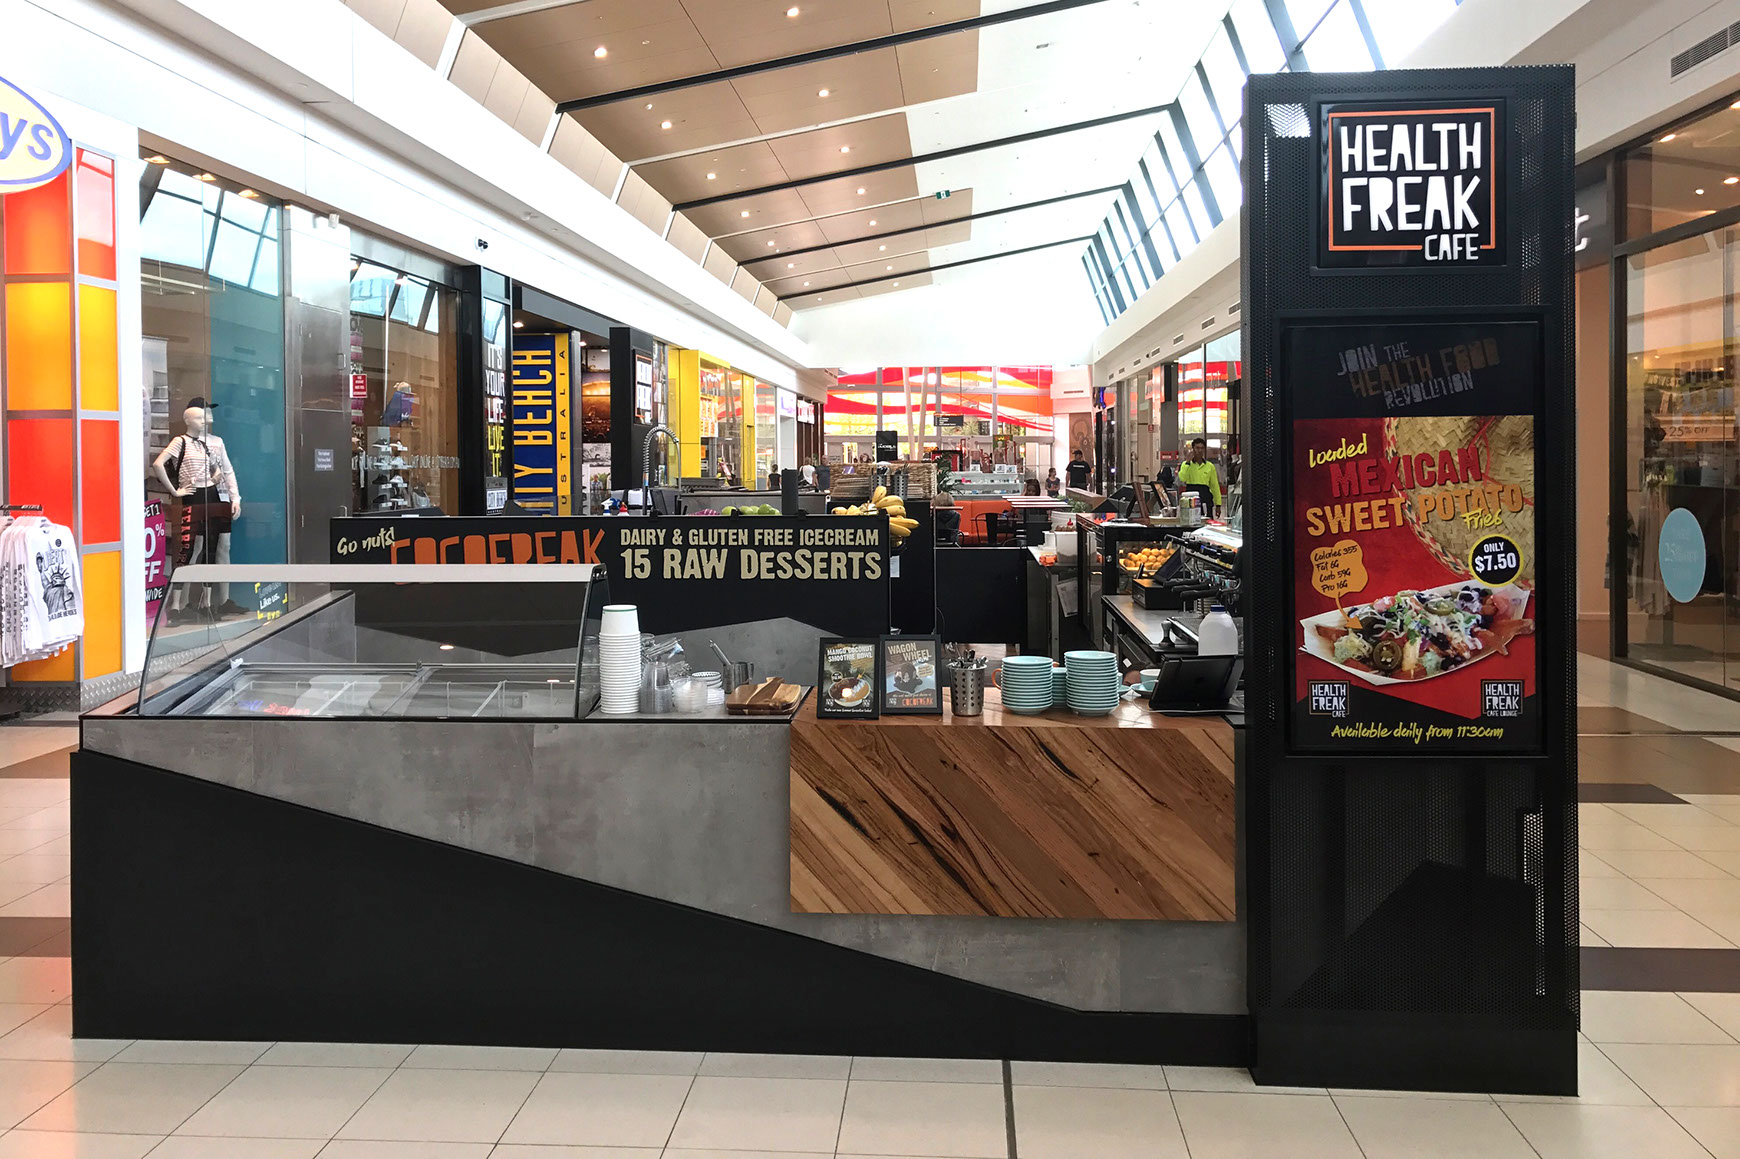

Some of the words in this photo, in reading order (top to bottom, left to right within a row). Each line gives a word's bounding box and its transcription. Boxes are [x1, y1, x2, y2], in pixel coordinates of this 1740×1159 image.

[1340, 122, 1482, 172] HEALTH
[1342, 175, 1481, 231] FREAK
[1424, 233, 1479, 261] CAFE
[1337, 344, 1378, 376] JOIN
[1384, 341, 1410, 362] THE
[1349, 353, 1433, 398] HEALTH
[1439, 337, 1500, 374] FOOD
[1384, 370, 1474, 409] REVOLUTION
[1329, 447, 1483, 498] MEXICAN
[1306, 497, 1406, 537] SWEET
[1417, 483, 1524, 525] POTATO
[1460, 507, 1503, 530] Fries
[337, 536, 358, 556] Go
[620, 528, 666, 546] DAIRY
[672, 528, 683, 545] &
[688, 528, 749, 546] GLUTEN
[754, 528, 794, 546] FREE
[800, 528, 879, 546] ICECREAM
[1314, 548, 1342, 562] Calories
[1343, 545, 1358, 555] 355
[1483, 542, 1505, 554] ONLY
[620, 548, 651, 580] 15
[663, 548, 728, 580] RAW
[740, 548, 882, 580] DESSERTS
[1315, 562, 1329, 572] Fat
[1474, 553, 1517, 574] $7.50
[1319, 571, 1336, 583] Carb
[1321, 584, 1335, 593] Pro
[888, 642, 917, 655] WAGON
[903, 649, 932, 661] WHEEL
[1311, 684, 1347, 697] HEALTH
[1485, 683, 1520, 696] HEALTH
[1312, 697, 1347, 711] FREAK
[1485, 696, 1520, 710] FREAK
[1332, 710, 1347, 718] CAFE
[1331, 722, 1393, 739] Available
[1393, 722, 1422, 745] daily
[1425, 725, 1453, 742] from
